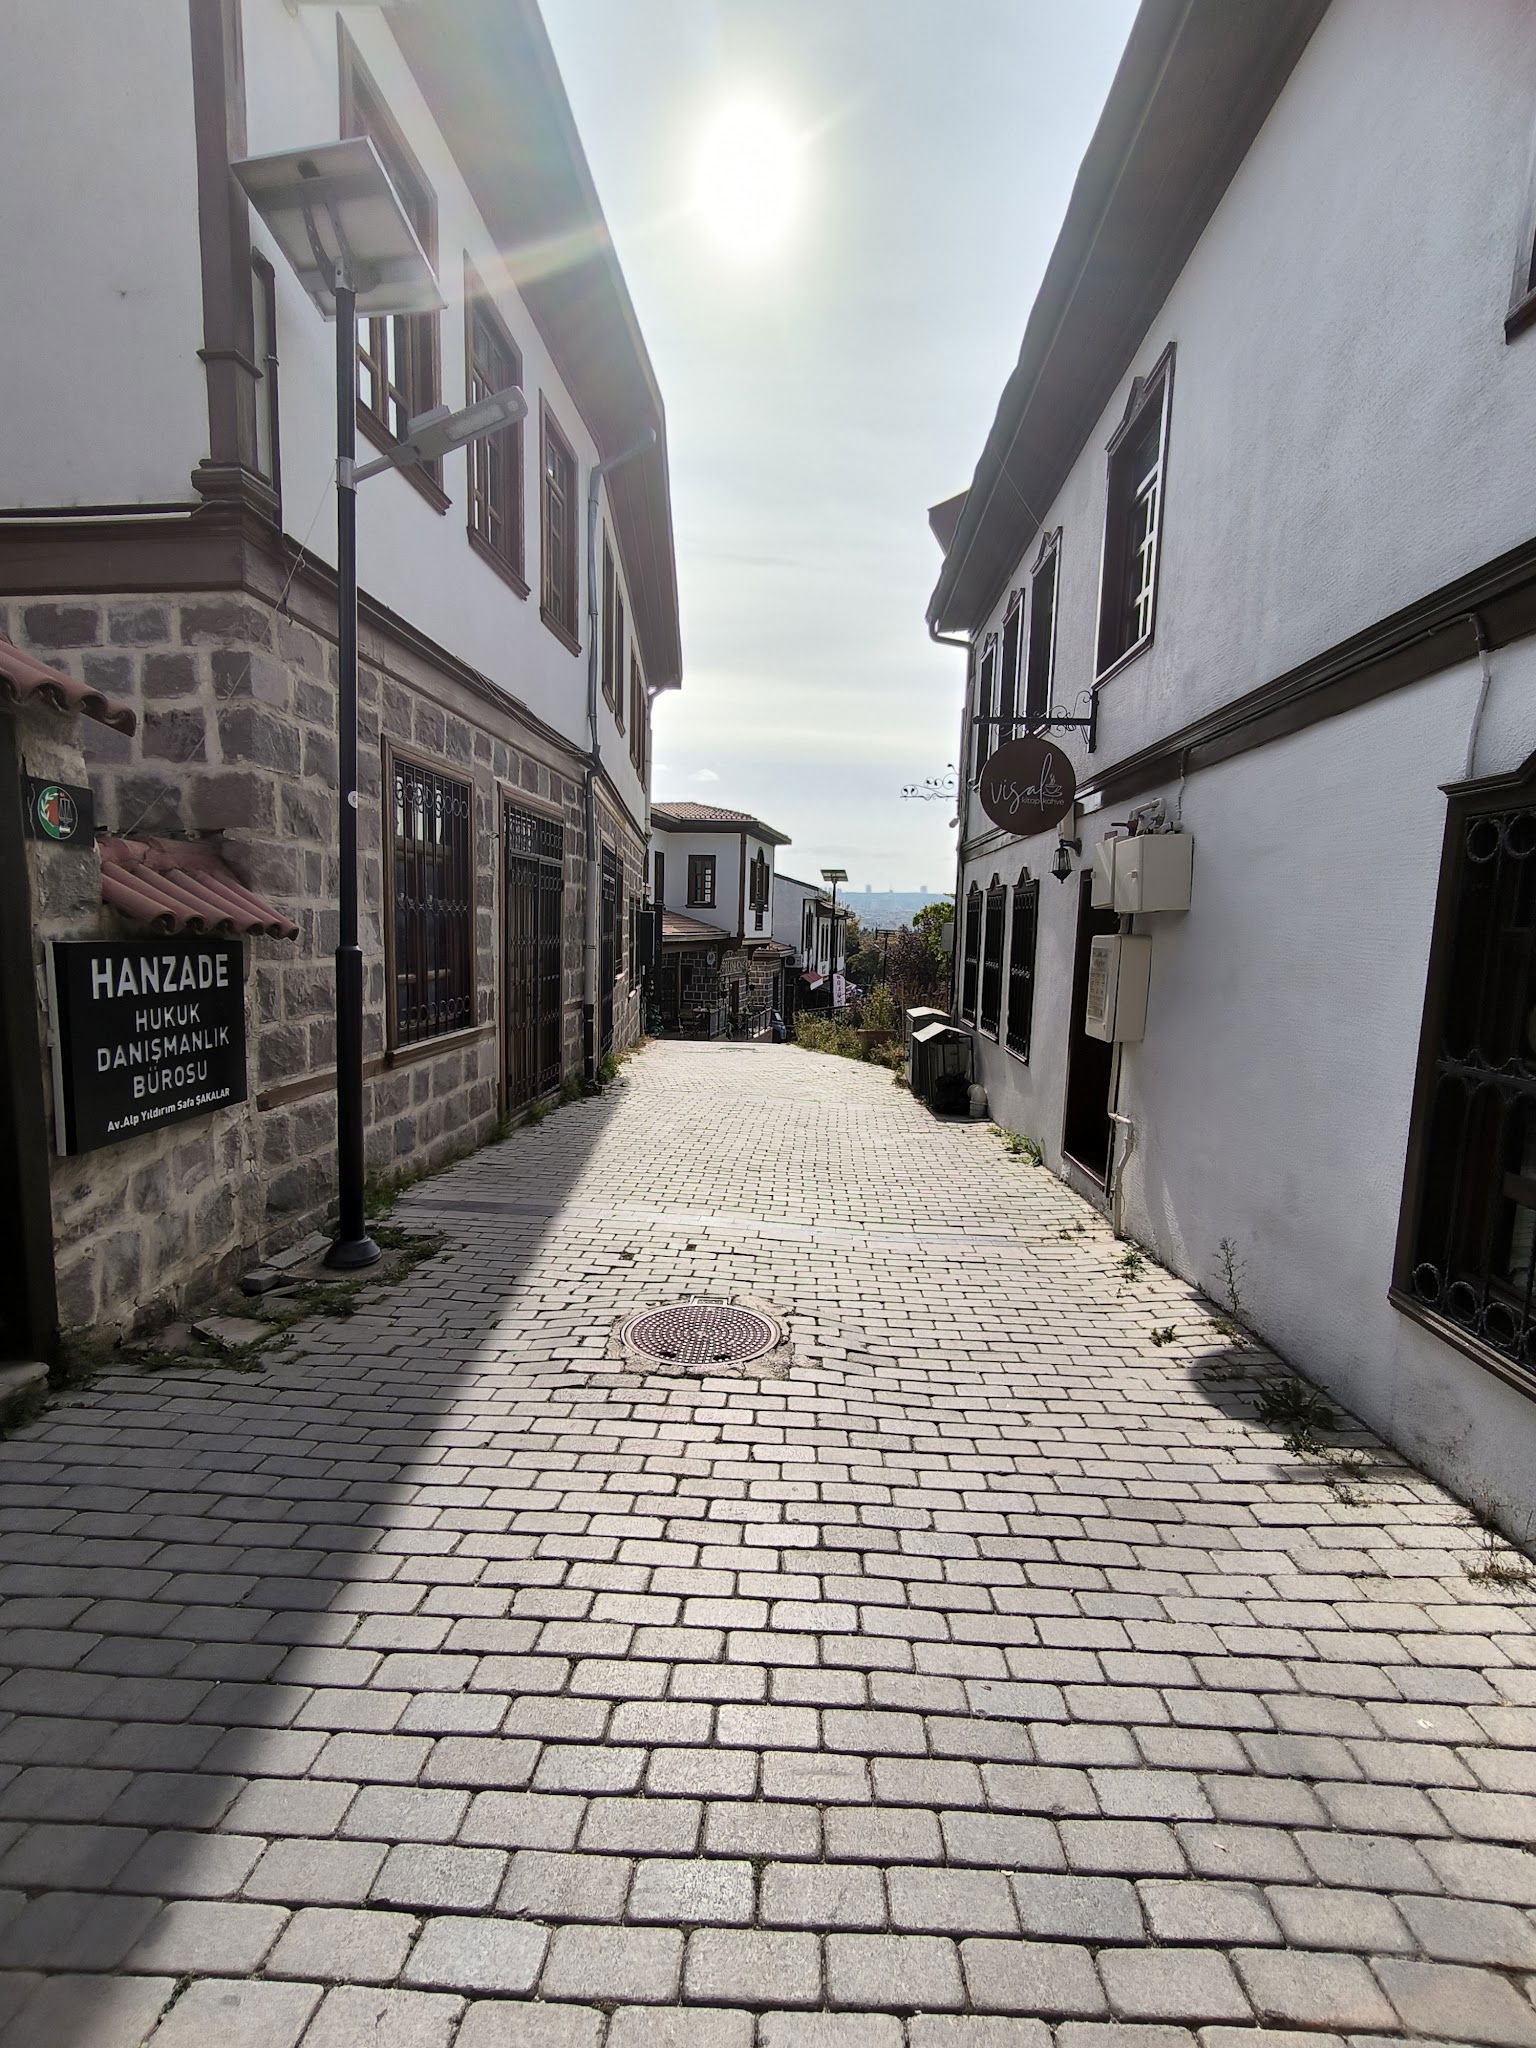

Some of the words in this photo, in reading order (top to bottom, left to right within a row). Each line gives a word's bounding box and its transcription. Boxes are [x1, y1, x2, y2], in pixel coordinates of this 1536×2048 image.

[91, 953, 229, 1000] HANZADE
[135, 1003, 201, 1033] HUKUK
[97, 1026, 230, 1072] DANIŞMANLIK
[133, 1060, 208, 1099] BÜROSU
[107, 1115, 140, 1133] Av.Alp
[141, 1104, 176, 1121] Yıldırım
[177, 1097, 195, 1111] Safa
[195, 1087, 230, 1106] ŞAKALAR
